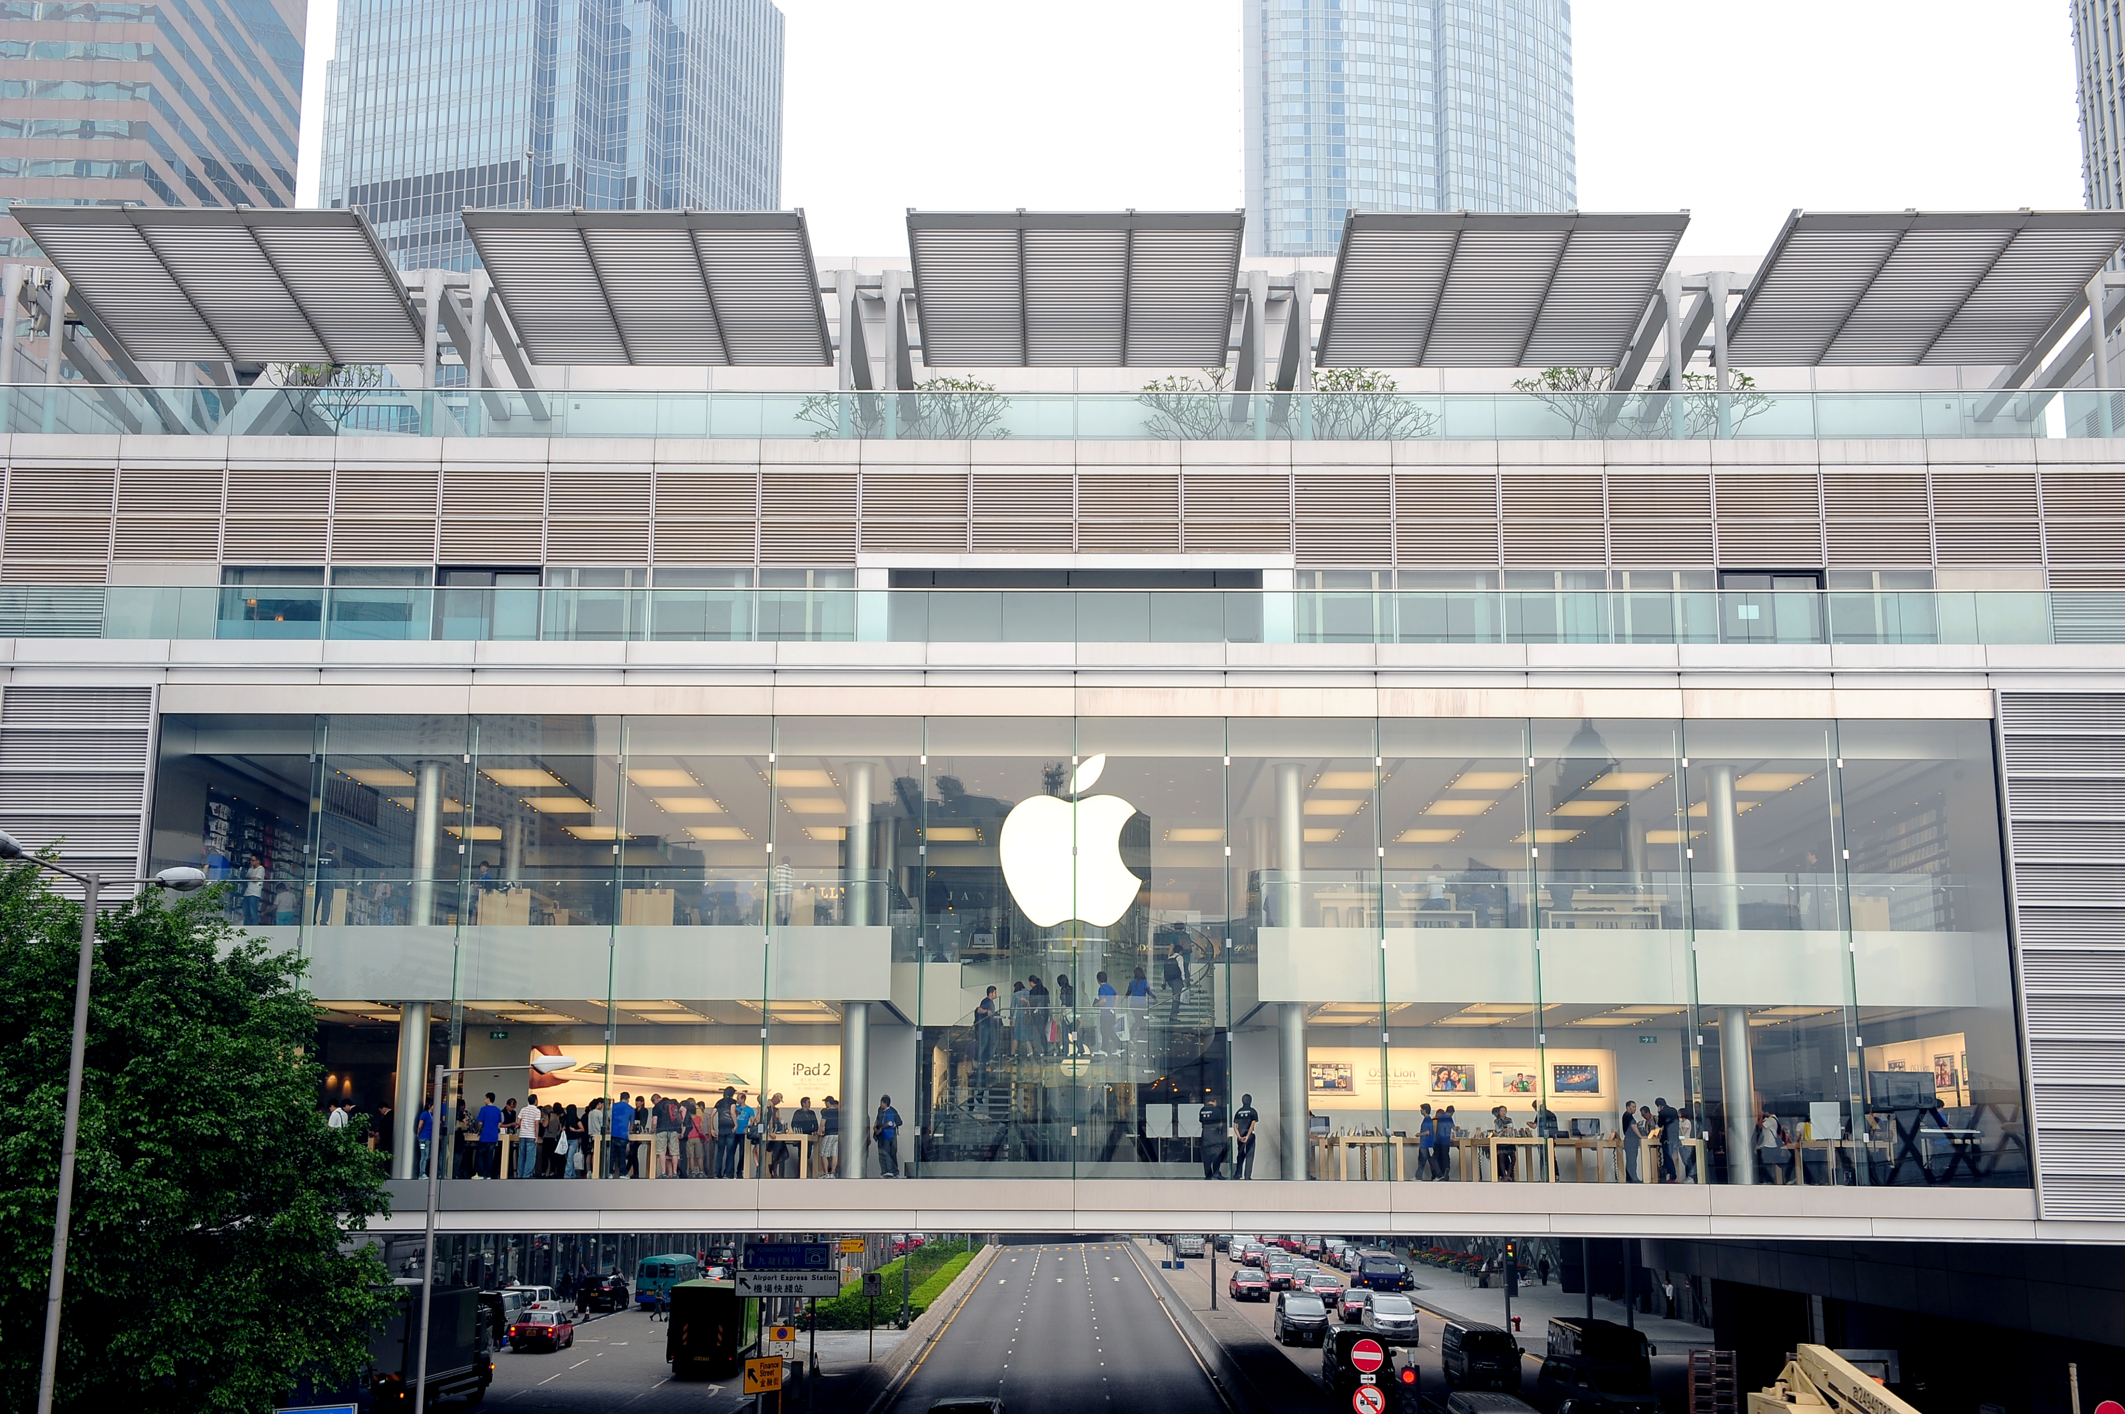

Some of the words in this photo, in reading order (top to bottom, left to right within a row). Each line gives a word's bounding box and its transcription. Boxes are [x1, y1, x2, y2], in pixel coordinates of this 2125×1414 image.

[792, 1062, 820, 1076] iPad
[822, 1063, 831, 1076] 2
[1393, 1067, 1416, 1078] Lion
[753, 1274, 778, 1282] Airport
[780, 1274, 808, 1282] Express
[760, 1362, 779, 1370] Finance
[760, 1369, 775, 1377] Street
